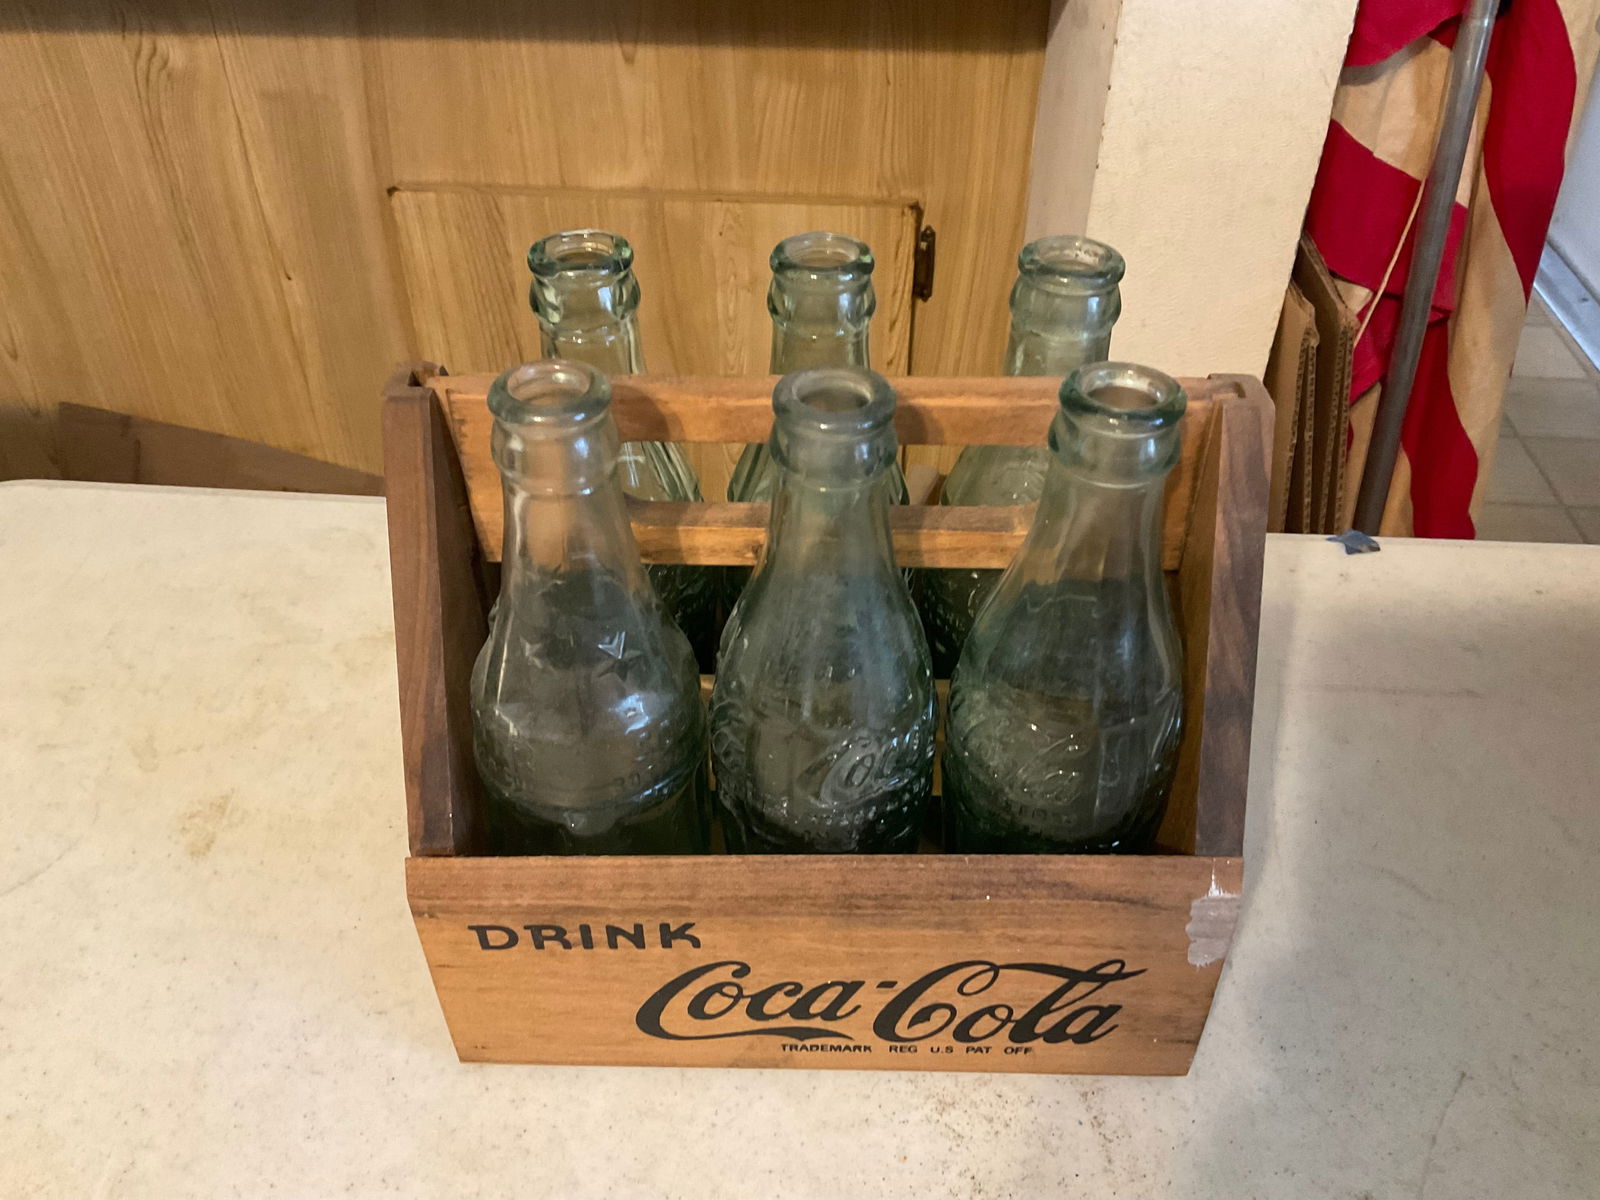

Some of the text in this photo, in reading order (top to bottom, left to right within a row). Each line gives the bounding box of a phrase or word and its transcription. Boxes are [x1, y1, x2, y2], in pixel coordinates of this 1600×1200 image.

[467, 922, 702, 950] DRINK
[635, 960, 1149, 1045] Coca-Cola
[781, 1043, 872, 1053] TRADEMARK
[889, 1044, 918, 1054] REG
[966, 1045, 993, 1055] PAT
[1004, 1045, 1034, 1056] OFF
